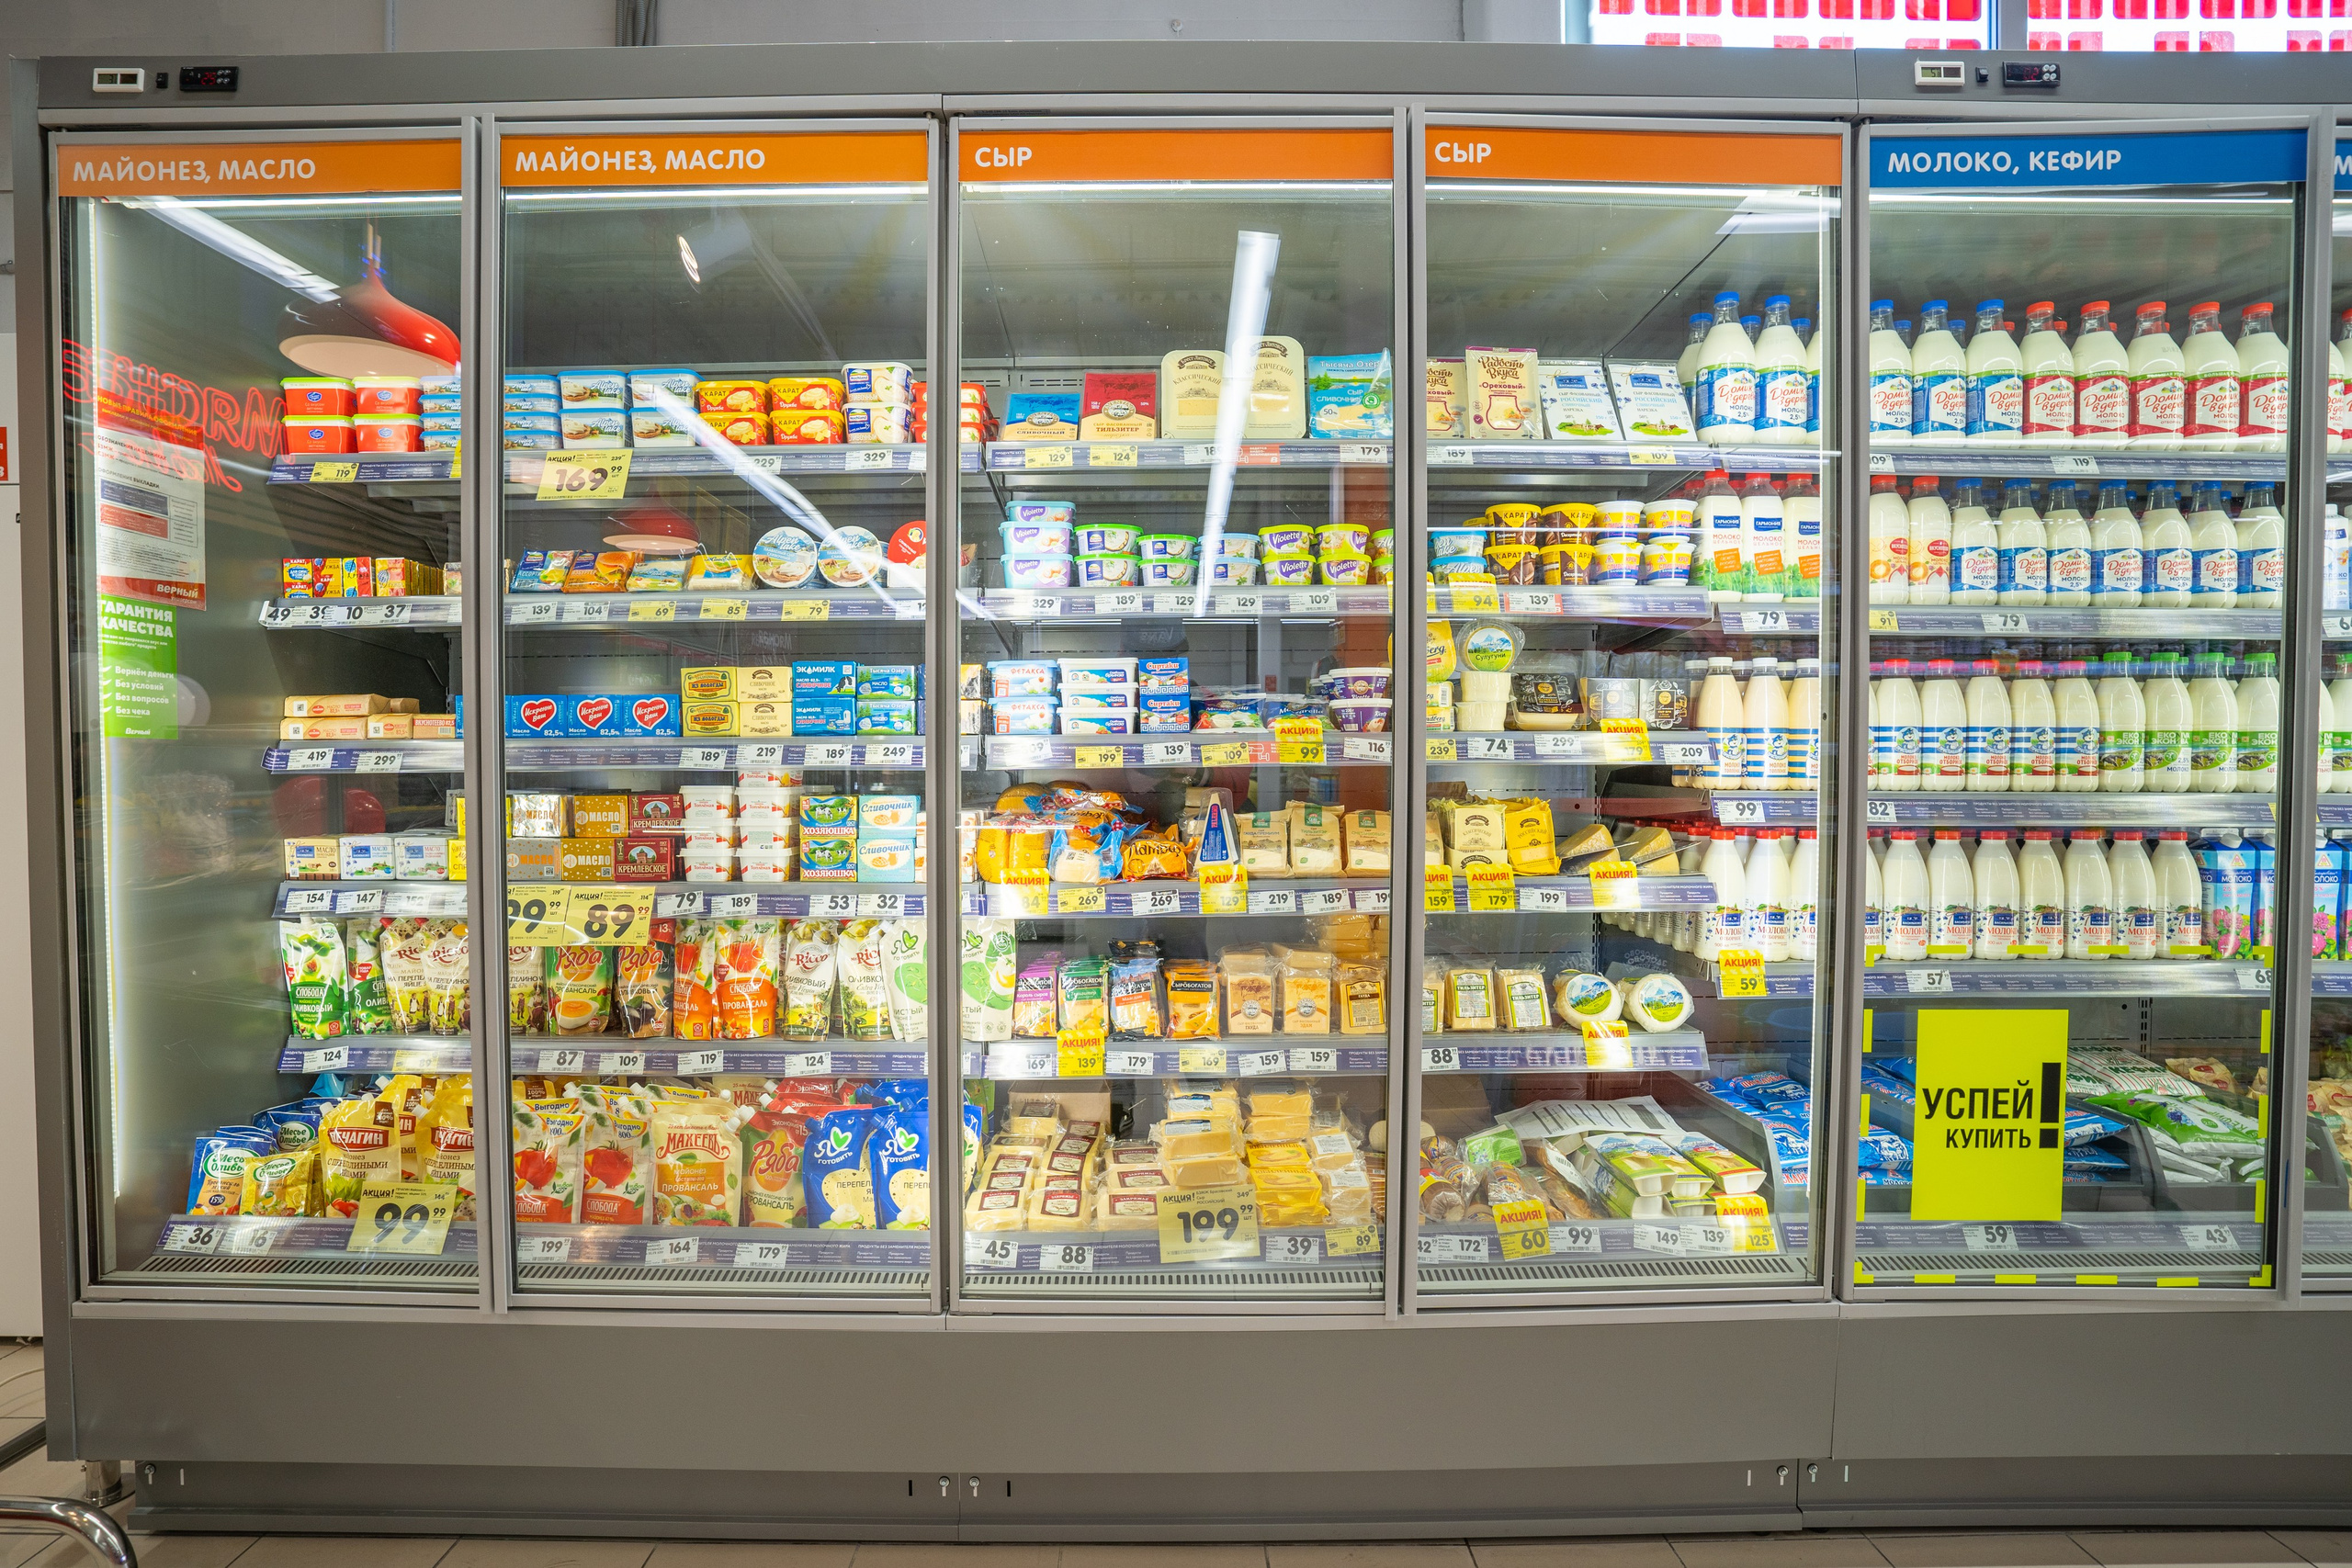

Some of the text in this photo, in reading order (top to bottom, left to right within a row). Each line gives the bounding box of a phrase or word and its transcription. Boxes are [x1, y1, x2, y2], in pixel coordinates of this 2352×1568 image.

[975, 146, 1032, 167] СЫР
[1434, 142, 1492, 164] СЫР
[515, 146, 764, 174] МАЙОНЕЗ, МАСЛО
[1888, 149, 2122, 175] МОЛОКО, КЕФИР
[74, 156, 316, 182] МАЙОНЕЗ, МАСЛО
[1478, 356, 1524, 369] Радость
[1487, 367, 1520, 380] Вкуса
[592, 379, 619, 391] Alpen
[2034, 392, 2071, 406] Домик
[2143, 394, 2183, 408] Домик
[864, 453, 886, 462] 329
[2073, 458, 2089, 467] 119
[555, 468, 608, 491] 169
[765, 535, 799, 545] Alpen
[1272, 532, 1300, 544] Violette
[781, 542, 801, 551] lake
[1282, 561, 1307, 572] Violette
[1237, 597, 1255, 606] 129
[1309, 595, 1329, 604] 109
[1529, 595, 1549, 604] 139
[384, 604, 406, 617] 37
[583, 605, 602, 615] 104
[655, 608, 668, 616] 69
[1758, 612, 1780, 625] 79
[1880, 617, 1891, 626] 91
[1476, 652, 1507, 661] Сулугуни
[115, 666, 174, 680] Вернём деньги
[115, 680, 164, 691] Без условий
[115, 693, 169, 705] Без вопросов
[116, 706, 130, 715] Без
[525, 705, 552, 717] Искренне
[588, 712, 602, 722] Ваш
[1368, 742, 1385, 752] 116
[1486, 739, 1508, 752] 74
[1553, 737, 1574, 747] 299
[308, 751, 326, 761] 419
[883, 747, 905, 757] 249
[1430, 746, 1450, 755] 239
[1681, 748, 1702, 757] 209
[861, 801, 912, 813] Сливочник
[1869, 802, 1890, 816] 82
[803, 827, 854, 835] ХОЗЯЮШКА
[859, 844, 910, 855] Сливочник
[618, 865, 666, 874] КРЕМЛЕВСКОЕ
[307, 893, 324, 903] 154
[356, 893, 375, 903] 147
[830, 896, 849, 909] 53
[876, 896, 898, 909] 32
[1151, 897, 1172, 907] 269
[1269, 895, 1288, 904] 219
[1322, 894, 1342, 904] 189
[1488, 895, 1508, 906] 179
[1540, 893, 1560, 903] 199
[584, 904, 635, 939] 89
[1927, 974, 1943, 985] 57
[296, 988, 323, 998] СЛОБОДА
[1062, 1038, 1100, 1048] АКЦИЯ!
[323, 1051, 341, 1061] 124
[557, 1052, 578, 1066] 87
[1260, 1055, 1279, 1066] 159
[1922, 1080, 2033, 1120] УСПЕЙ
[535, 1102, 570, 1111] Выгодно
[280, 1127, 306, 1136] Месье
[1946, 1128, 2031, 1148] КУПИТЬ
[749, 1141, 799, 1176] Ряба
[819, 1151, 853, 1165] ГОТОВИТЬ
[363, 1189, 395, 1198] АКЦИЯ!
[662, 1183, 718, 1192] ПРОВАНСАЛЬ
[586, 1201, 618, 1213] СЛОБОДА
[374, 1202, 430, 1245] 99
[1178, 1207, 1238, 1243] 199
[191, 1227, 213, 1246] 36
[1521, 1230, 1545, 1250] 60
[1656, 1232, 1679, 1246] 149
[1984, 1225, 2007, 1244] 59
[2206, 1228, 2228, 1243] 43
[669, 1241, 691, 1253] 164
[1287, 1237, 1312, 1255] 39
[1459, 1239, 1481, 1252] 172
[1749, 1235, 1770, 1247] 125
[986, 1241, 1010, 1258] 45
[1061, 1246, 1086, 1264] 88
